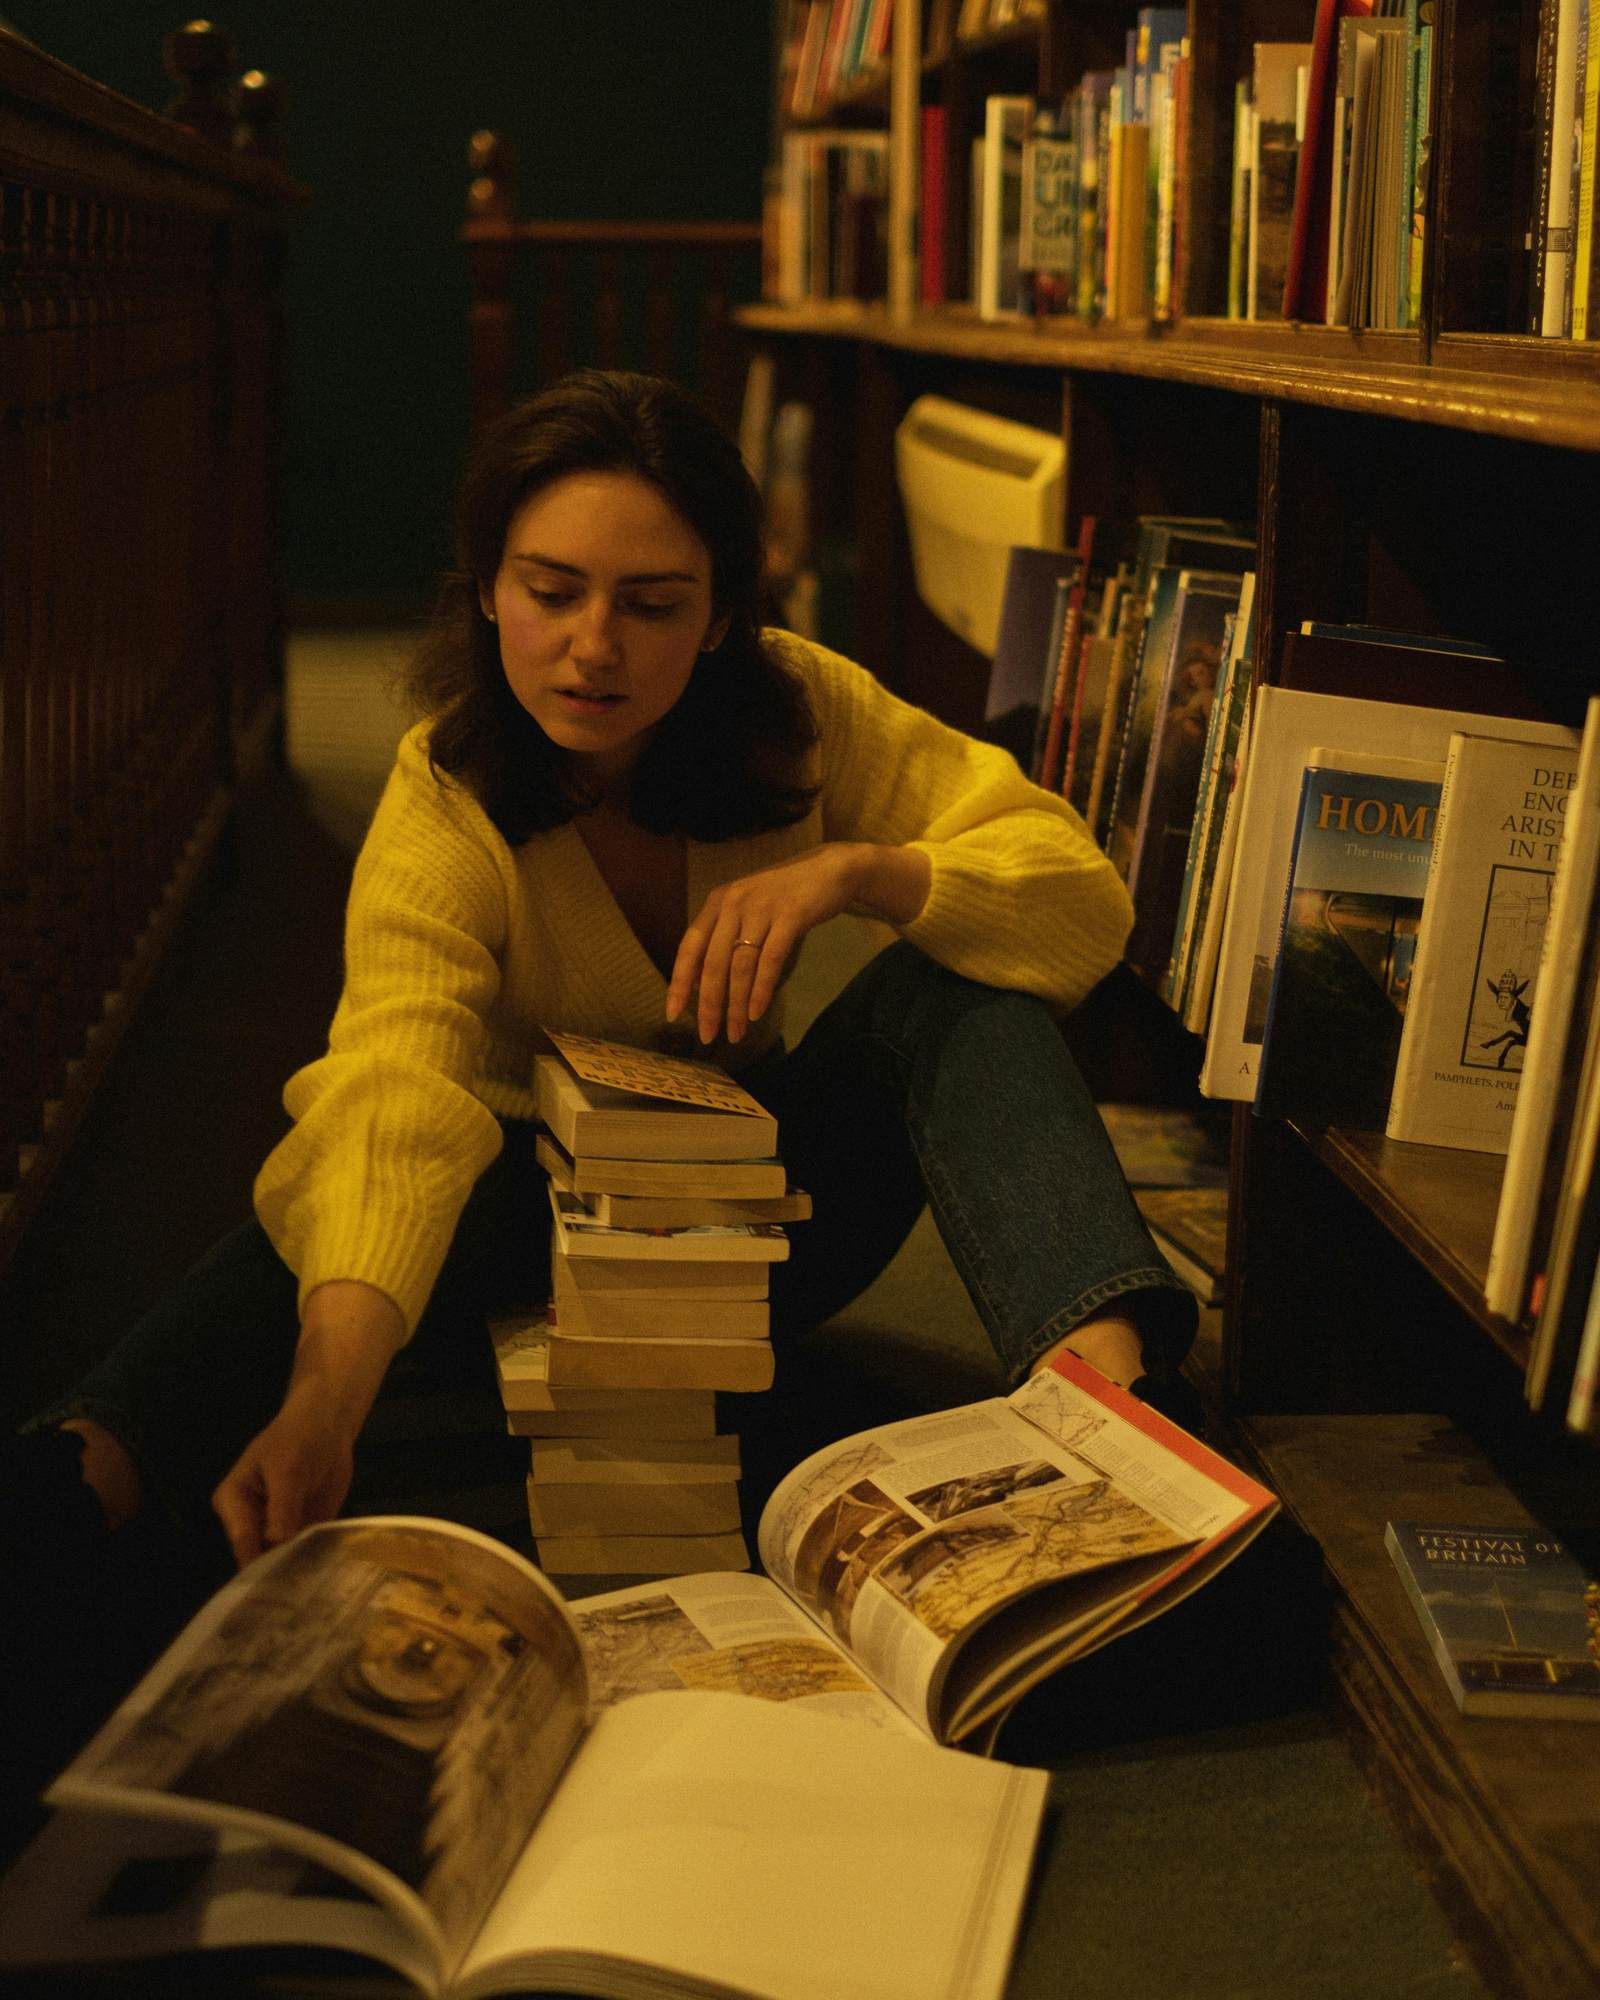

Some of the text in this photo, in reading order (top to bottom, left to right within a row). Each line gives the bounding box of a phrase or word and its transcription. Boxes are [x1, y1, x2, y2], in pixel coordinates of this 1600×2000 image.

[1536, 165, 1548, 288] ENGLAND
[1344, 843, 1370, 858] The
[1372, 850, 1404, 862] most
[1508, 838, 1536, 859] IN
[1238, 1062, 1250, 1074] A
[1418, 1535, 1563, 1554] FESTIVAL OF
[1425, 1549, 1527, 1565] BRITAIN
